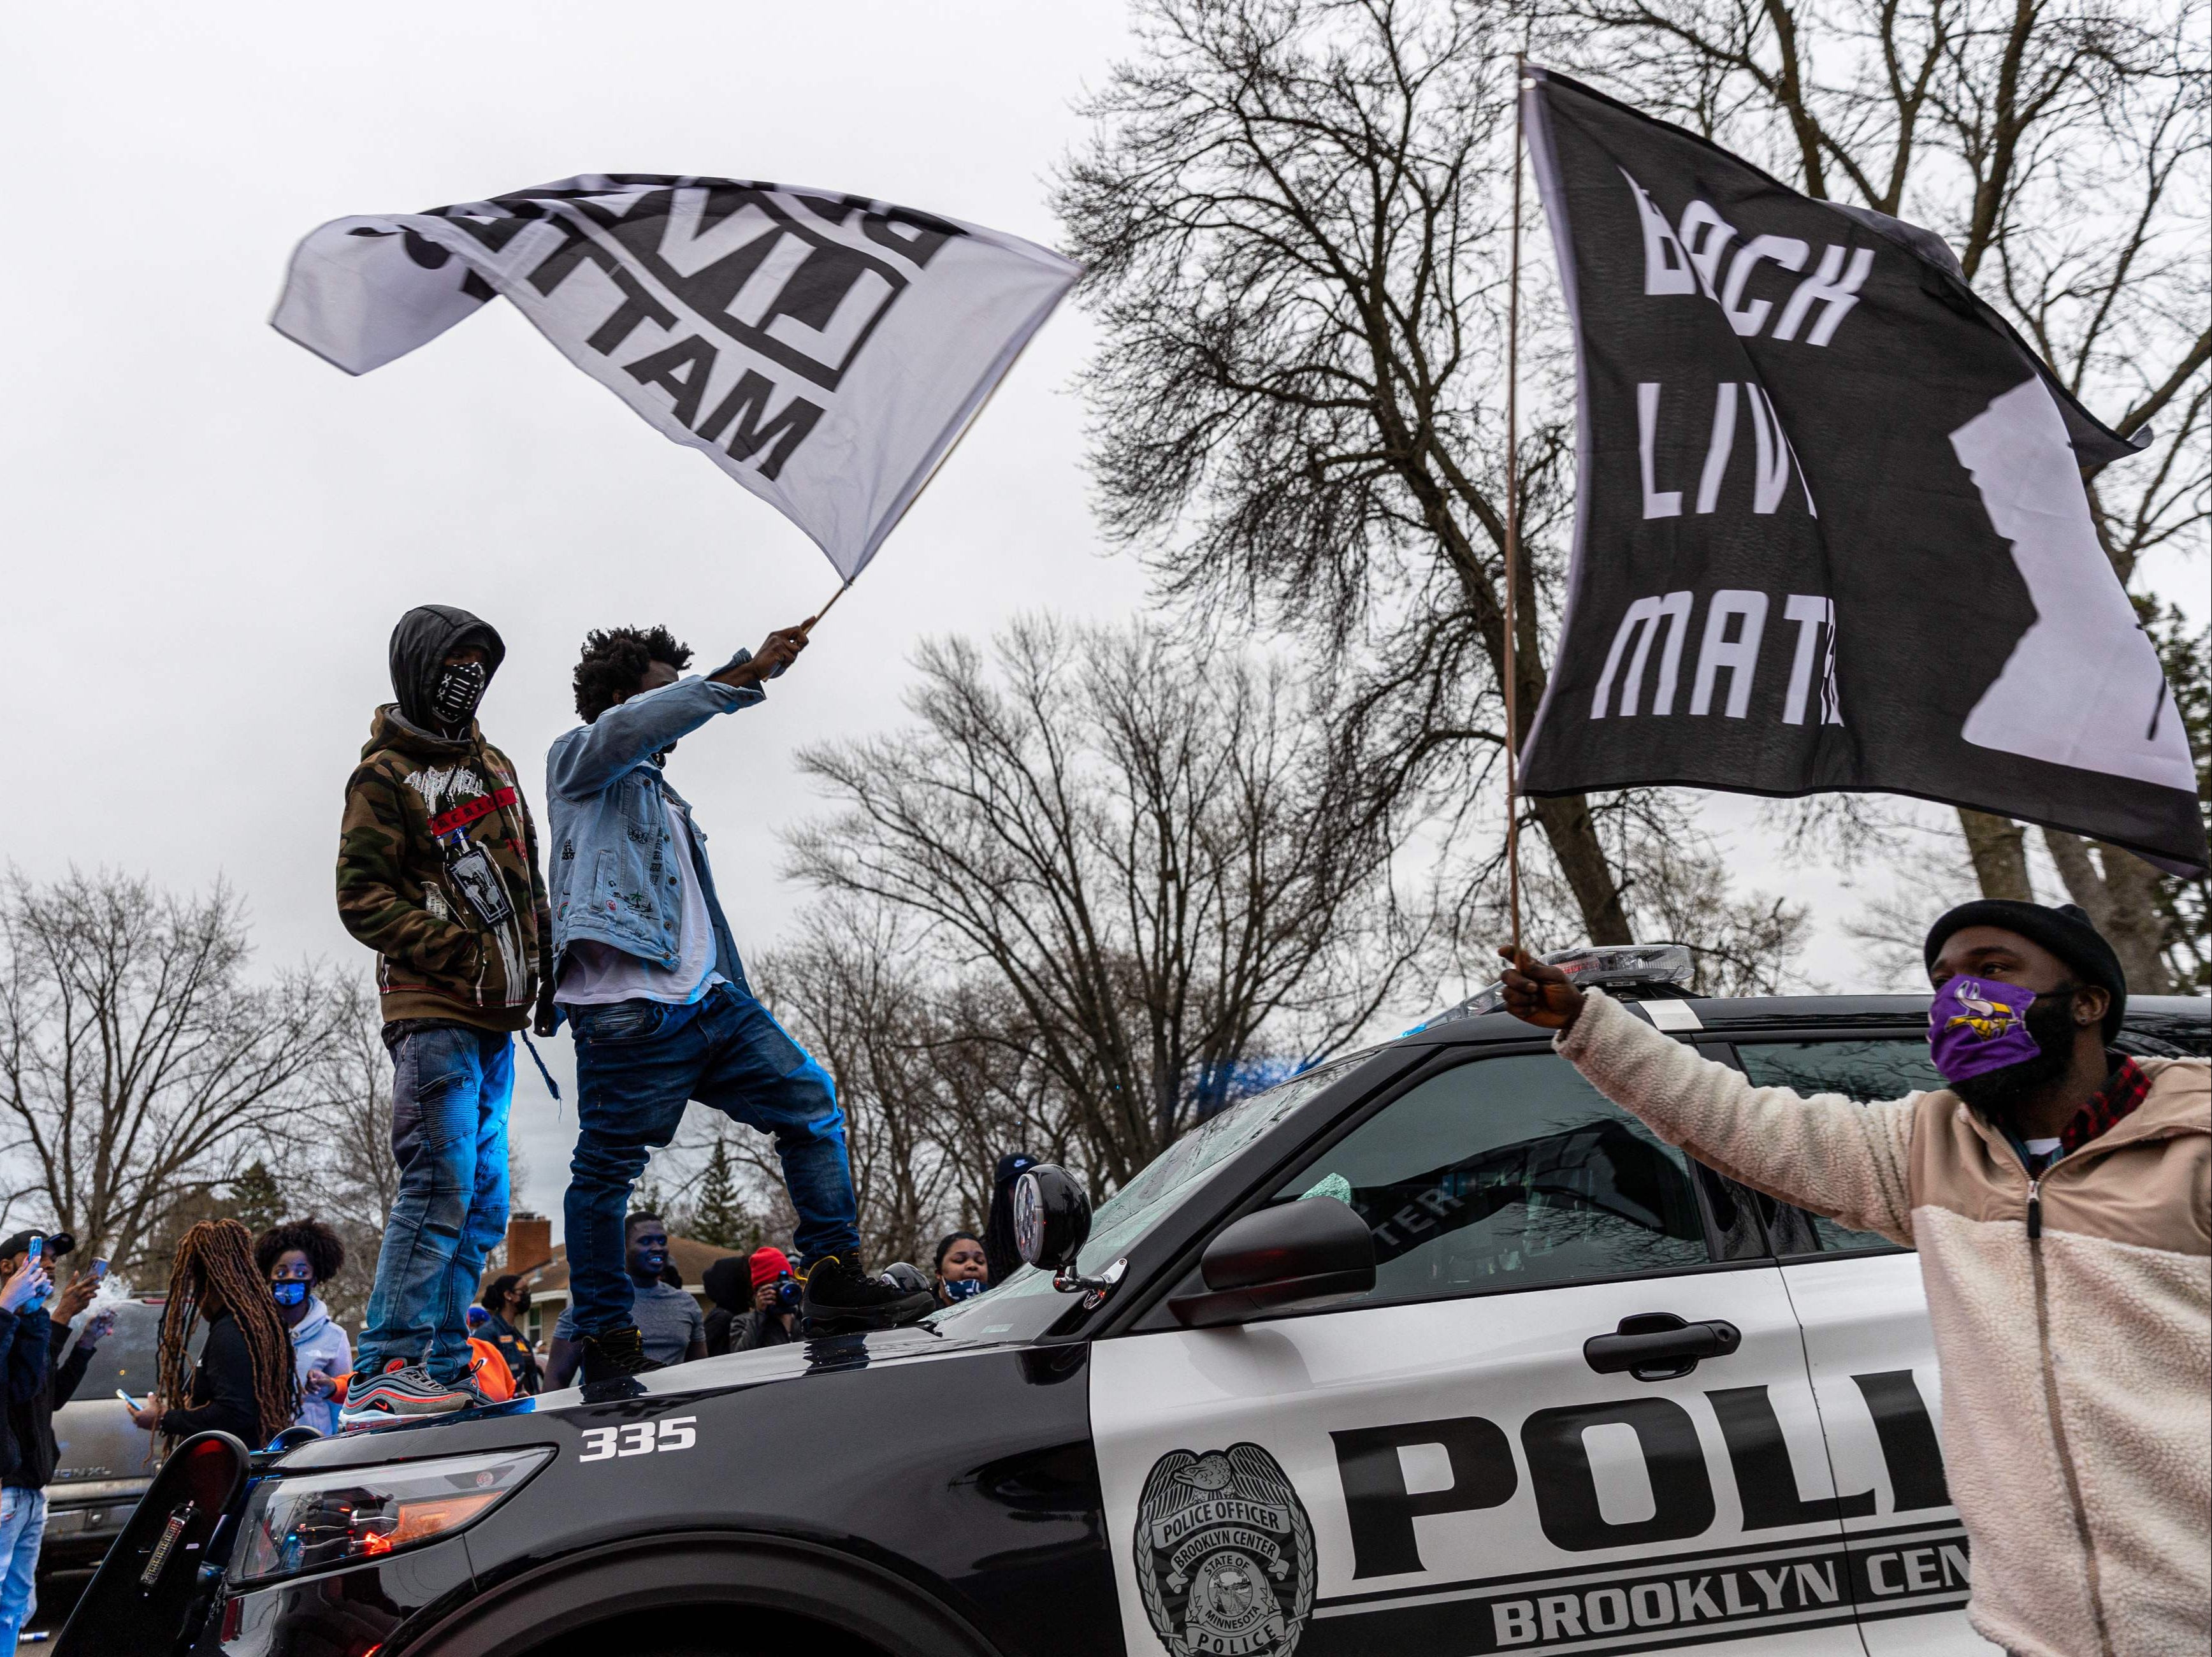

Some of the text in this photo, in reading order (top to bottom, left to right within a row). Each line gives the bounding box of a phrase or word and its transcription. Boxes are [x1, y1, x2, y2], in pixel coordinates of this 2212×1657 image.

[1636, 382, 1818, 520] LIV
[579, 1415, 697, 1463] 335
[1163, 1501, 1280, 1544] POLICE OFFICER
[1173, 1530, 1276, 1569] BROOKLYN CENTER
[1204, 1555, 1233, 1576] STATE
[1235, 1557, 1250, 1569] OF
[1204, 1605, 1261, 1630] MINNESOTA
[1491, 1560, 1840, 1647] BROOKLYN
[1197, 1624, 1276, 1654] POLICE
